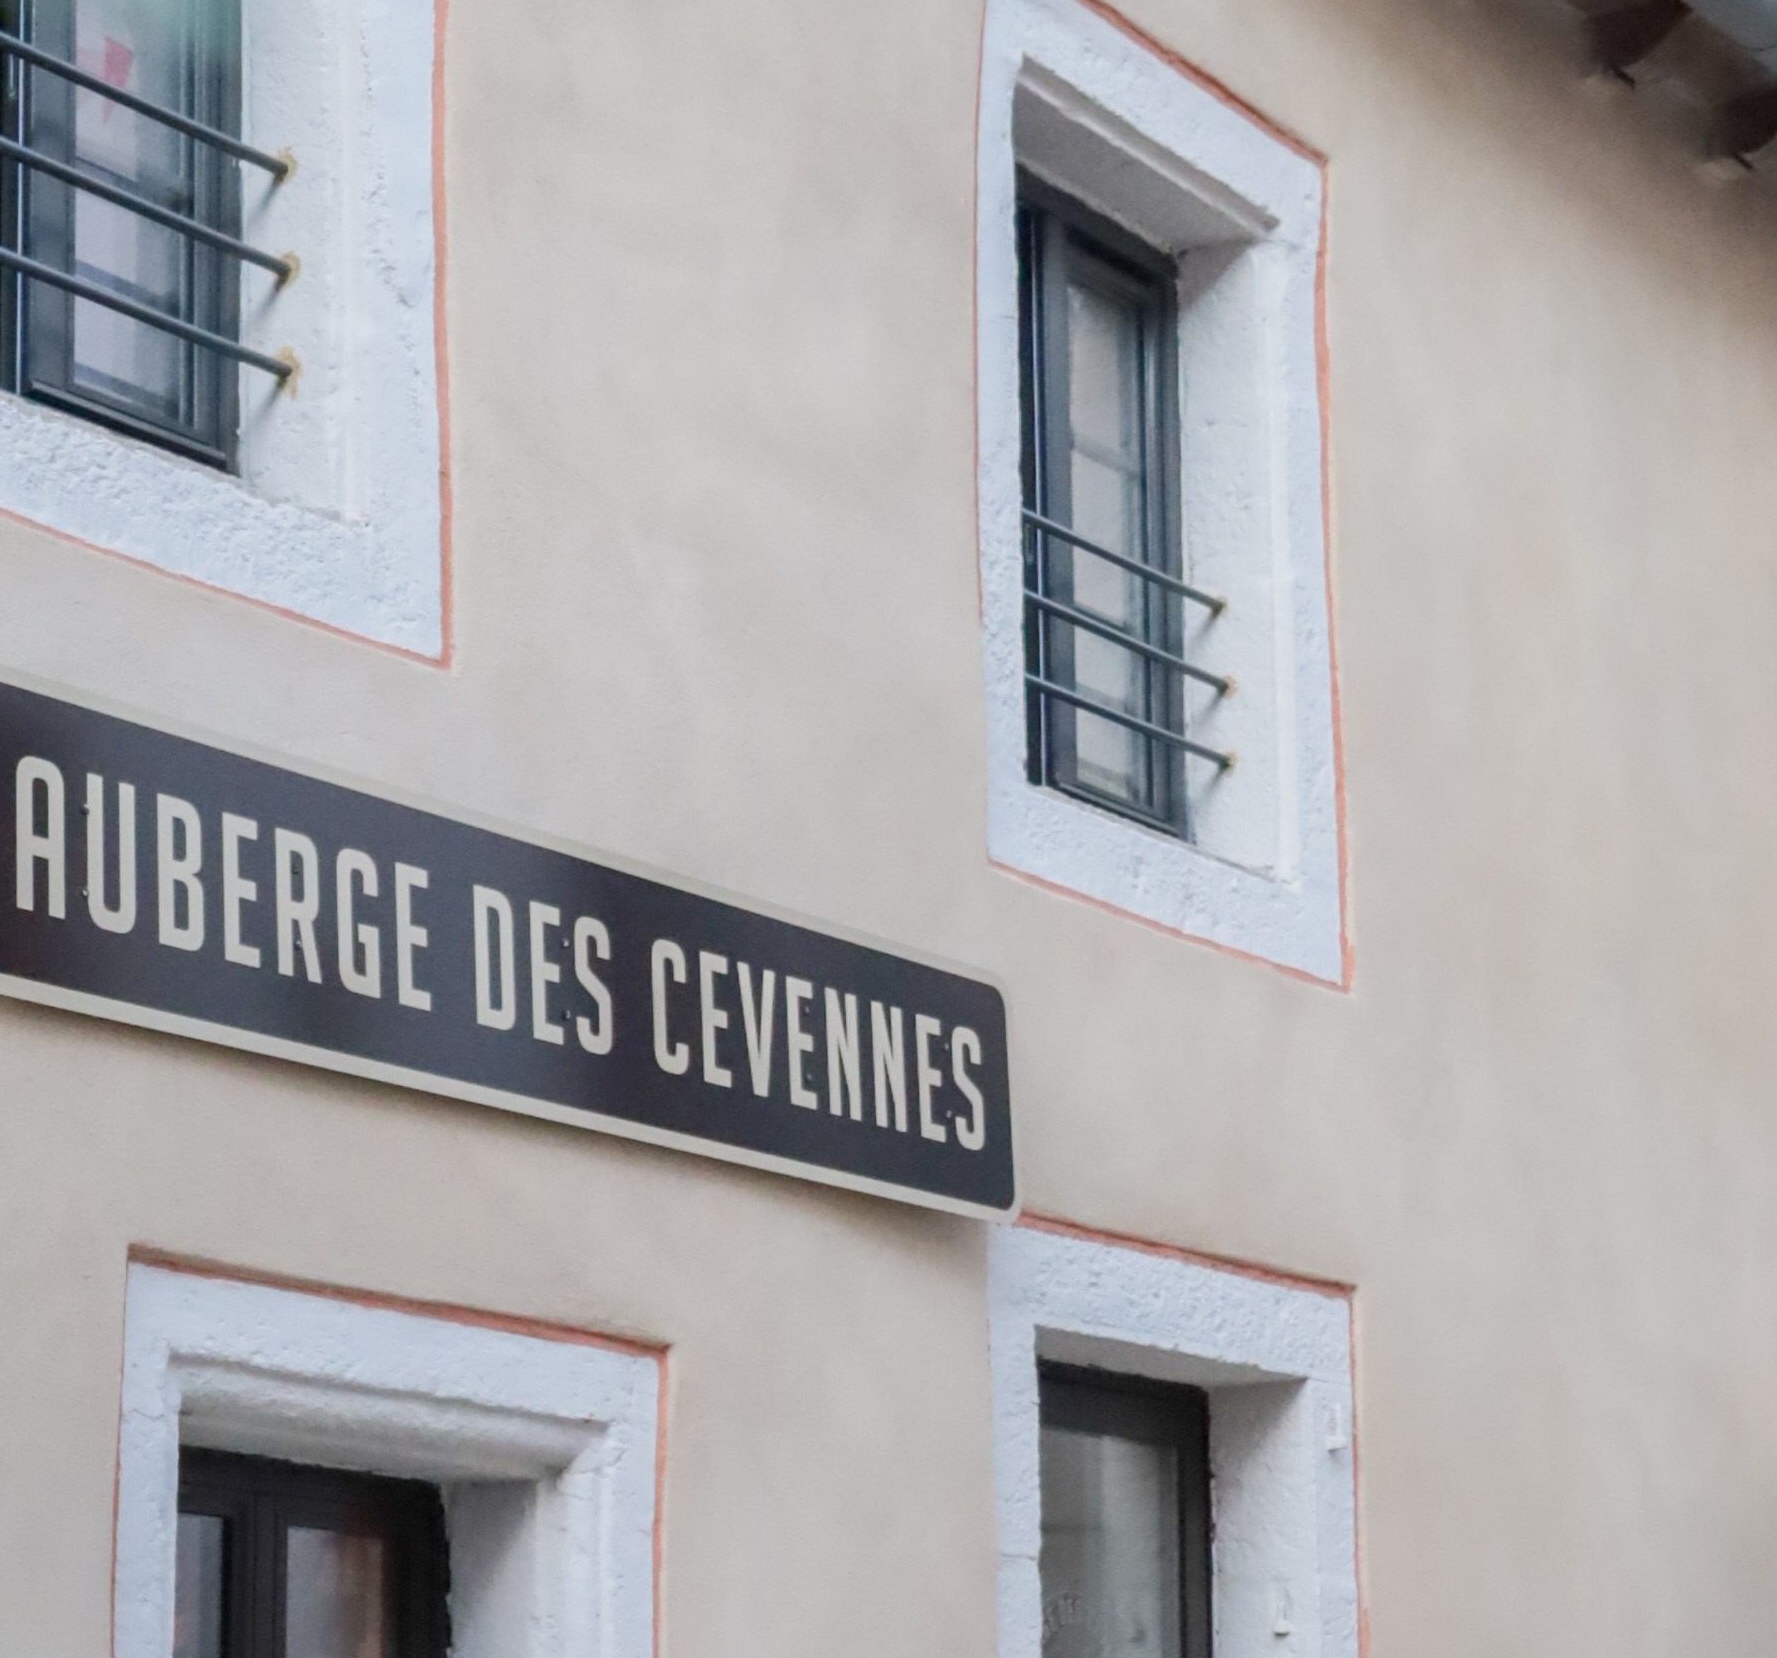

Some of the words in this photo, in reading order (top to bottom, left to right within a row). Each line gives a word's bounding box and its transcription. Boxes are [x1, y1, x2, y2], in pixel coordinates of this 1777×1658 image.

[15, 754, 432, 1012] AUBERGE
[472, 883, 614, 1056] DES
[650, 937, 986, 1151] CEVENNES
